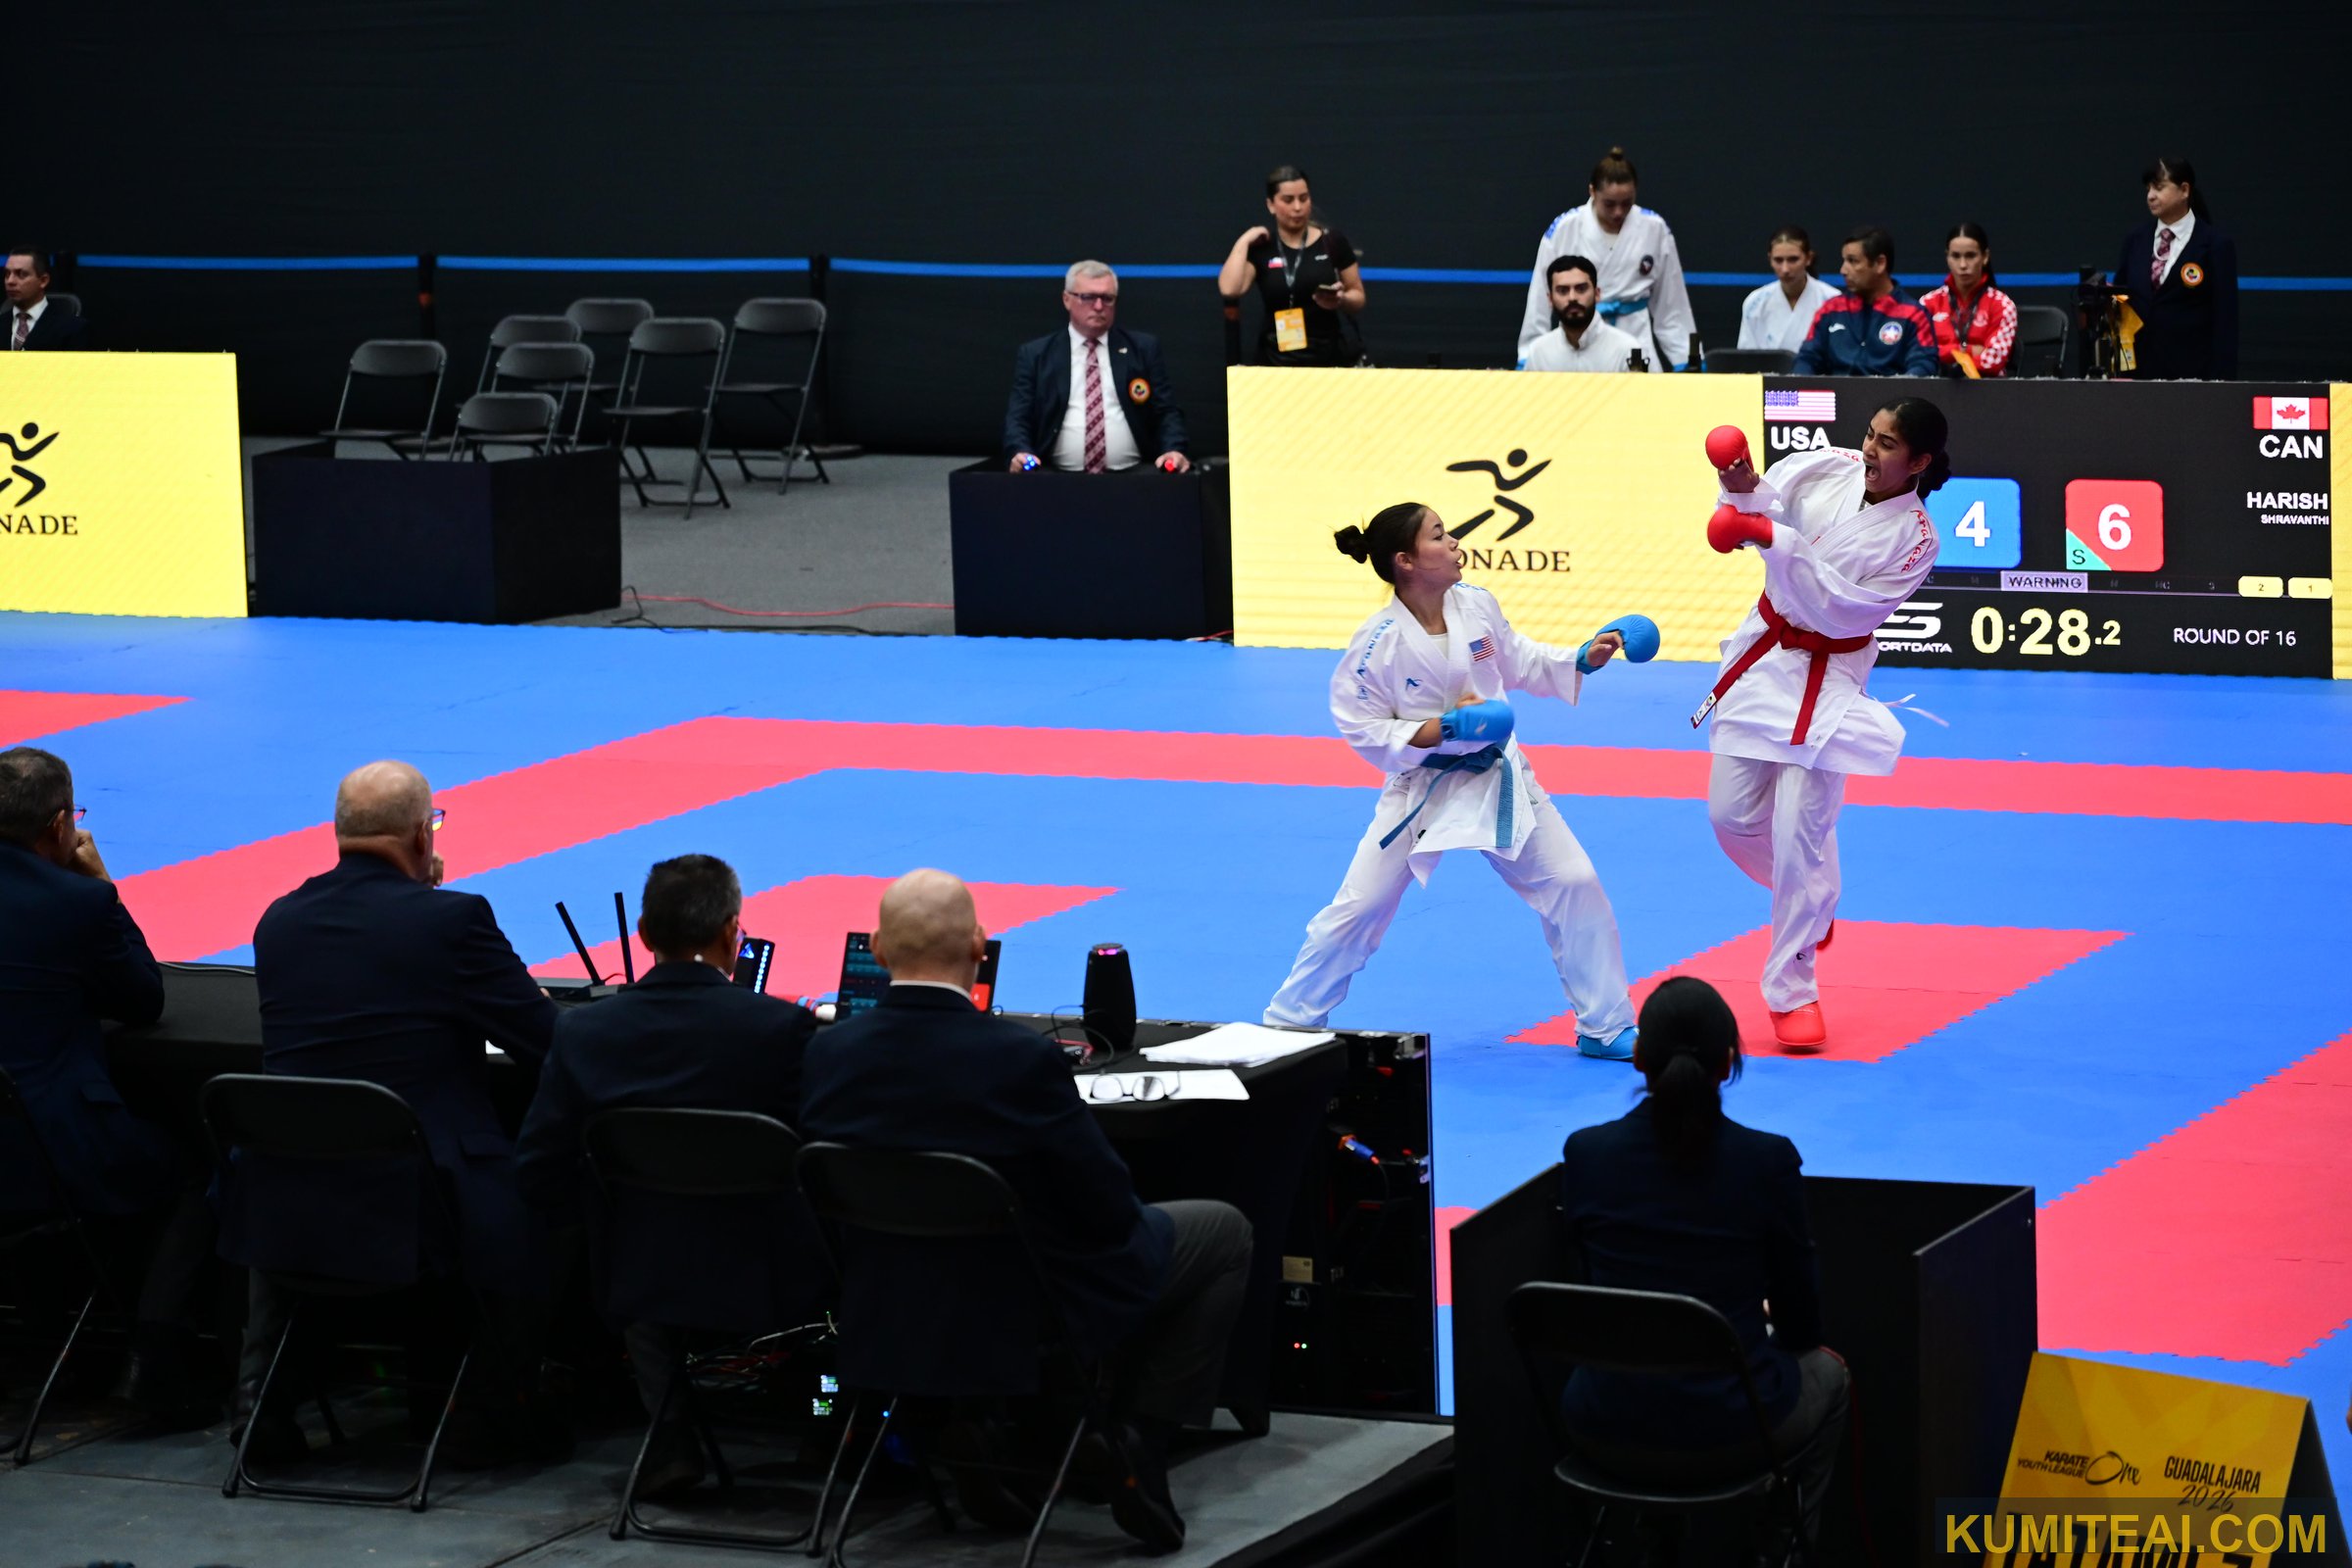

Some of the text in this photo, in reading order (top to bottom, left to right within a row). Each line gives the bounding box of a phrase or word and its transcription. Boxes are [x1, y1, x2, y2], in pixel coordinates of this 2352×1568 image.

[1771, 426, 1832, 450] USA
[2259, 434, 2324, 459] CAN
[2247, 491, 2328, 510] HARISH
[1955, 501, 1991, 547] 4
[2097, 503, 2132, 551] 6
[2260, 514, 2330, 525] SHRAVANTHI
[2072, 549, 2086, 565] S
[2008, 575, 2082, 589] WARNING
[2258, 583, 2265, 592] 2
[1878, 641, 1953, 653] ORTDATA
[2173, 627, 2297, 647] ROUND OF 16
[2017, 1458, 2085, 1480] YOUTH LEAGUE
[2043, 1450, 2090, 1469] KARATE
[2084, 1450, 2141, 1486] One
[2164, 1455, 2262, 1494] GUADALAJARA
[2178, 1485, 2237, 1513] 2026
